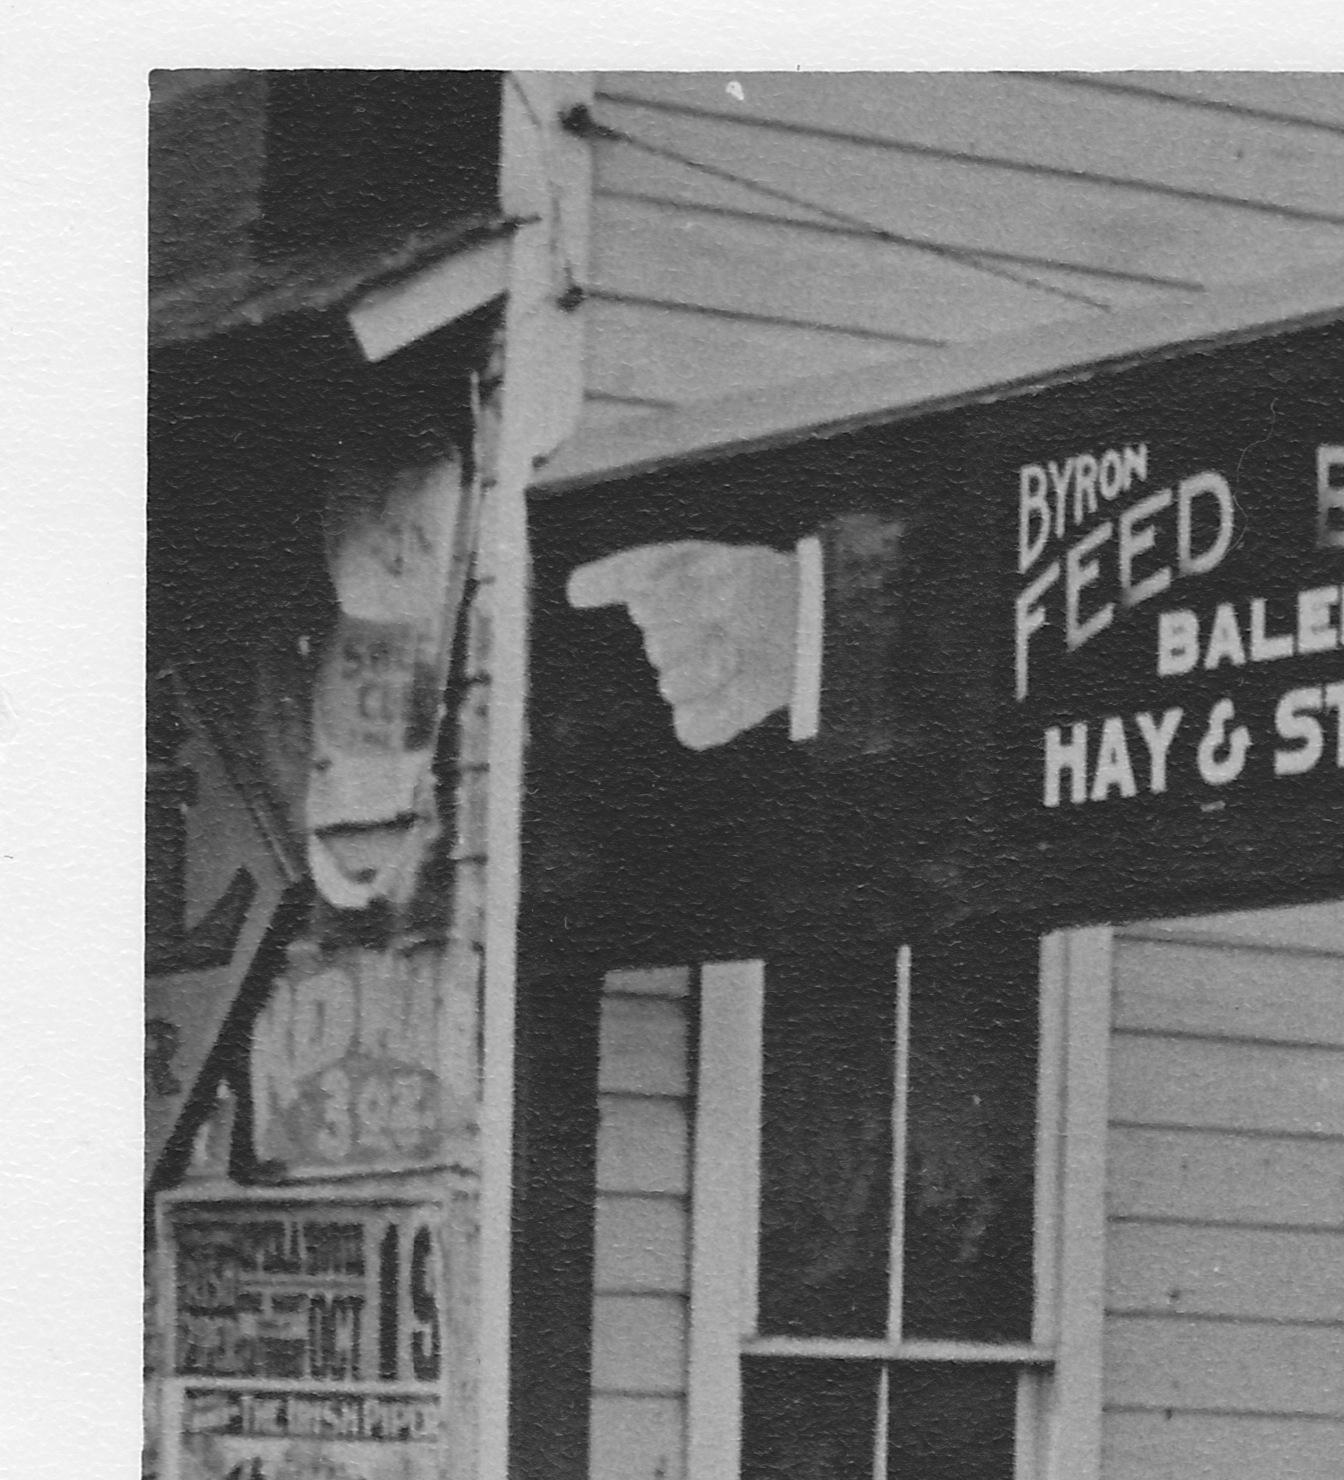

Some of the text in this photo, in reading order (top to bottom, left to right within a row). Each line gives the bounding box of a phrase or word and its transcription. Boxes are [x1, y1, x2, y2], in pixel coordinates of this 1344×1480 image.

[1018, 443, 1148, 574] BYRON
[1014, 470, 1236, 700] FEED
[1042, 707, 1185, 807] HAY
[1197, 698, 1253, 786] &
